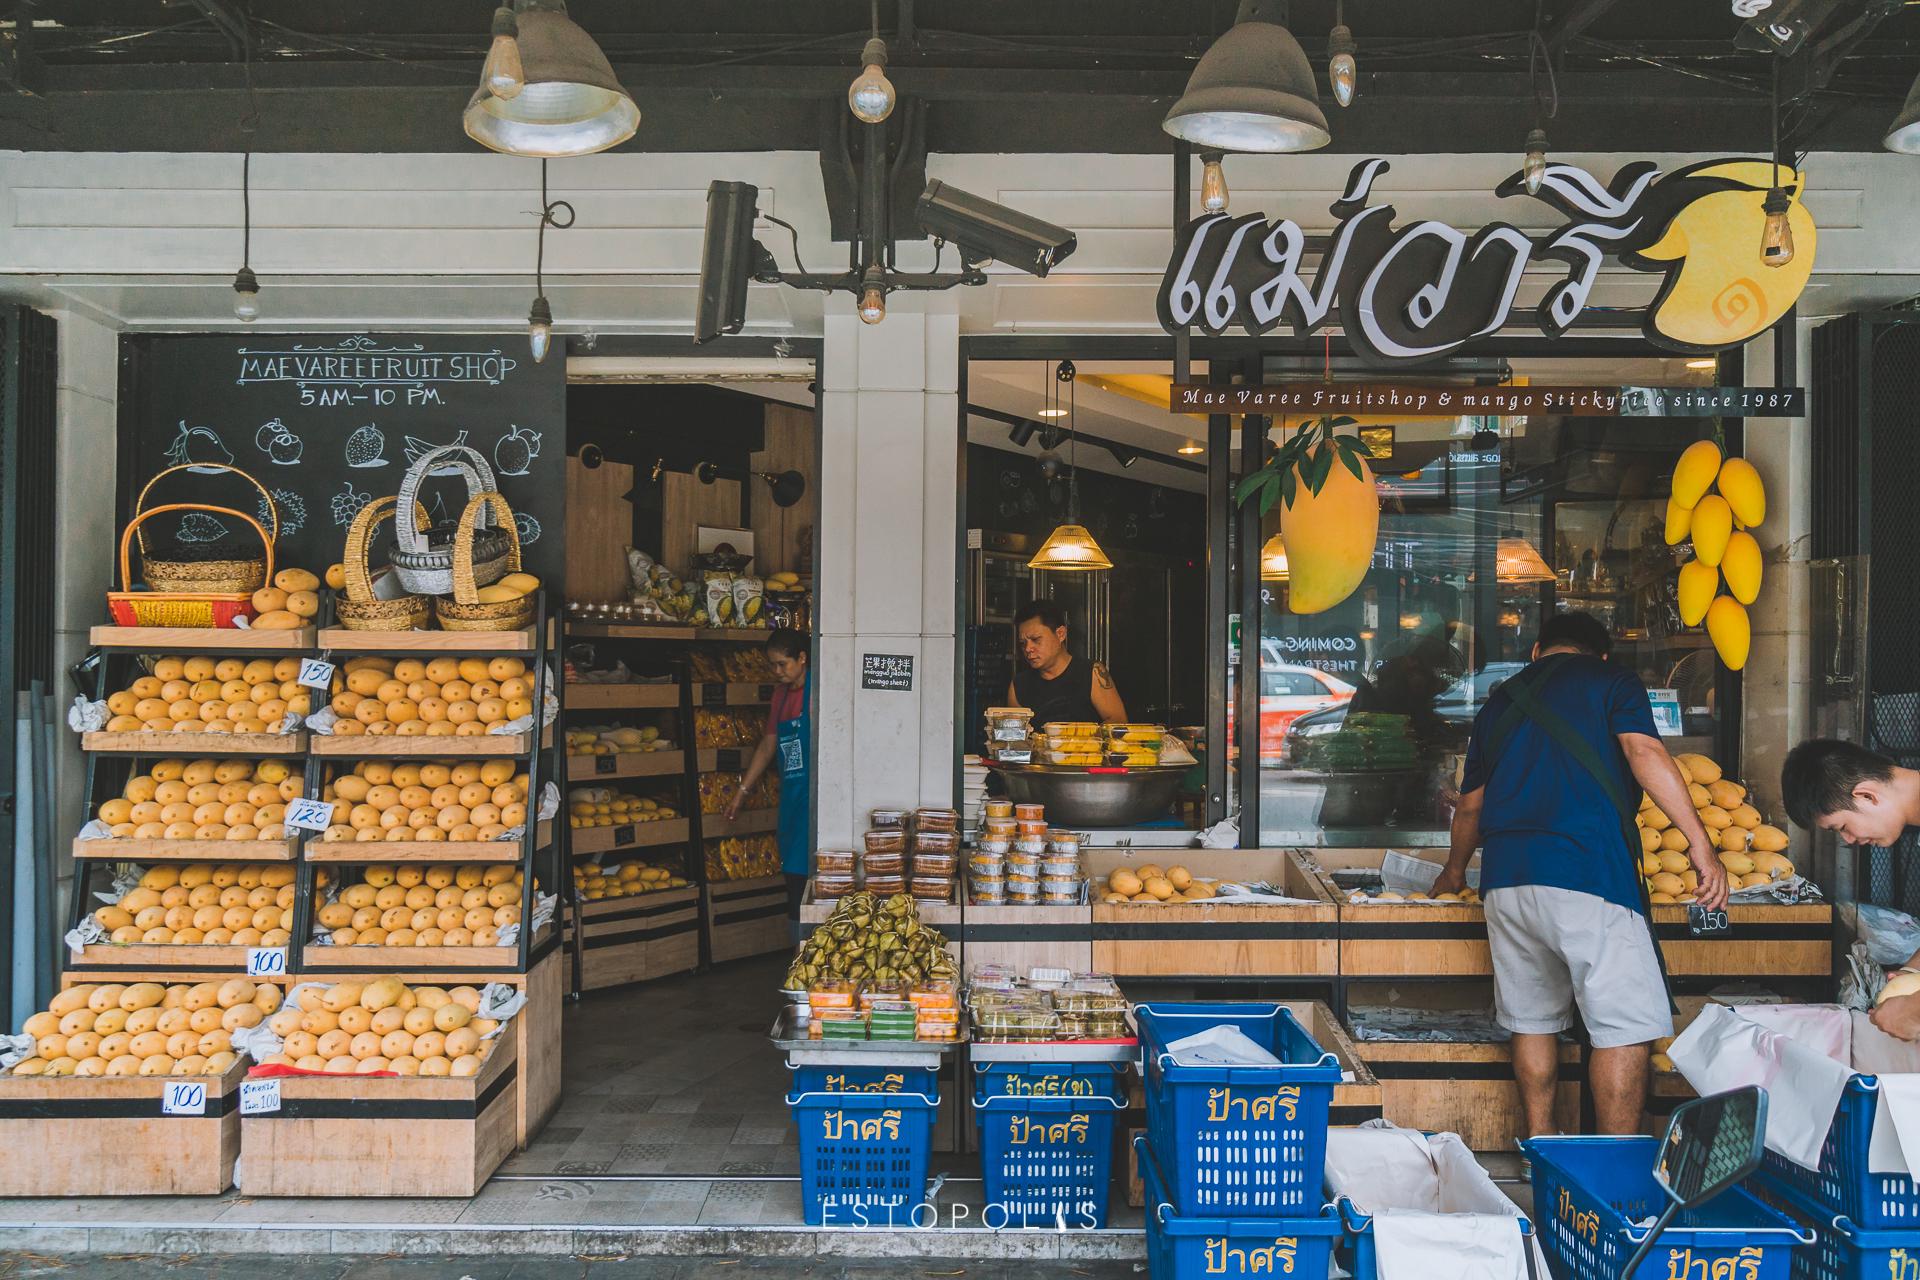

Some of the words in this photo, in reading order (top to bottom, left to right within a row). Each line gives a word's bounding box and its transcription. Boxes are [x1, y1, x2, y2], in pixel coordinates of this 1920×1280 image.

[1168, 159, 1661, 357] แม่วารี
[449, 356, 517, 380] SHOP
[374, 388, 396, 406] 10
[1183, 390, 1226, 405] Mae
[1237, 390, 1301, 405] Varee
[1312, 389, 1427, 410] Fruitshop
[1438, 395, 1452, 406] &
[1463, 394, 1532, 411] mango
[1673, 392, 1731, 407] since
[1741, 394, 1793, 408] 1987
[301, 662, 331, 682] 150
[290, 808, 327, 824] 120
[1699, 907, 1728, 930] 150
[254, 951, 283, 971] 100
[173, 1085, 203, 1107] 100
[261, 1093, 279, 1108] 100
[1207, 1086, 1301, 1121] ป้าศรี
[822, 1110, 902, 1140] ป้าศรี
[1010, 1114, 1089, 1143] ป้าศรี
[1559, 1186, 1600, 1247] ป้าศรี
[1204, 1237, 1298, 1273] ป้าศรี
[1667, 1247, 1763, 1280] ป้าศรี
